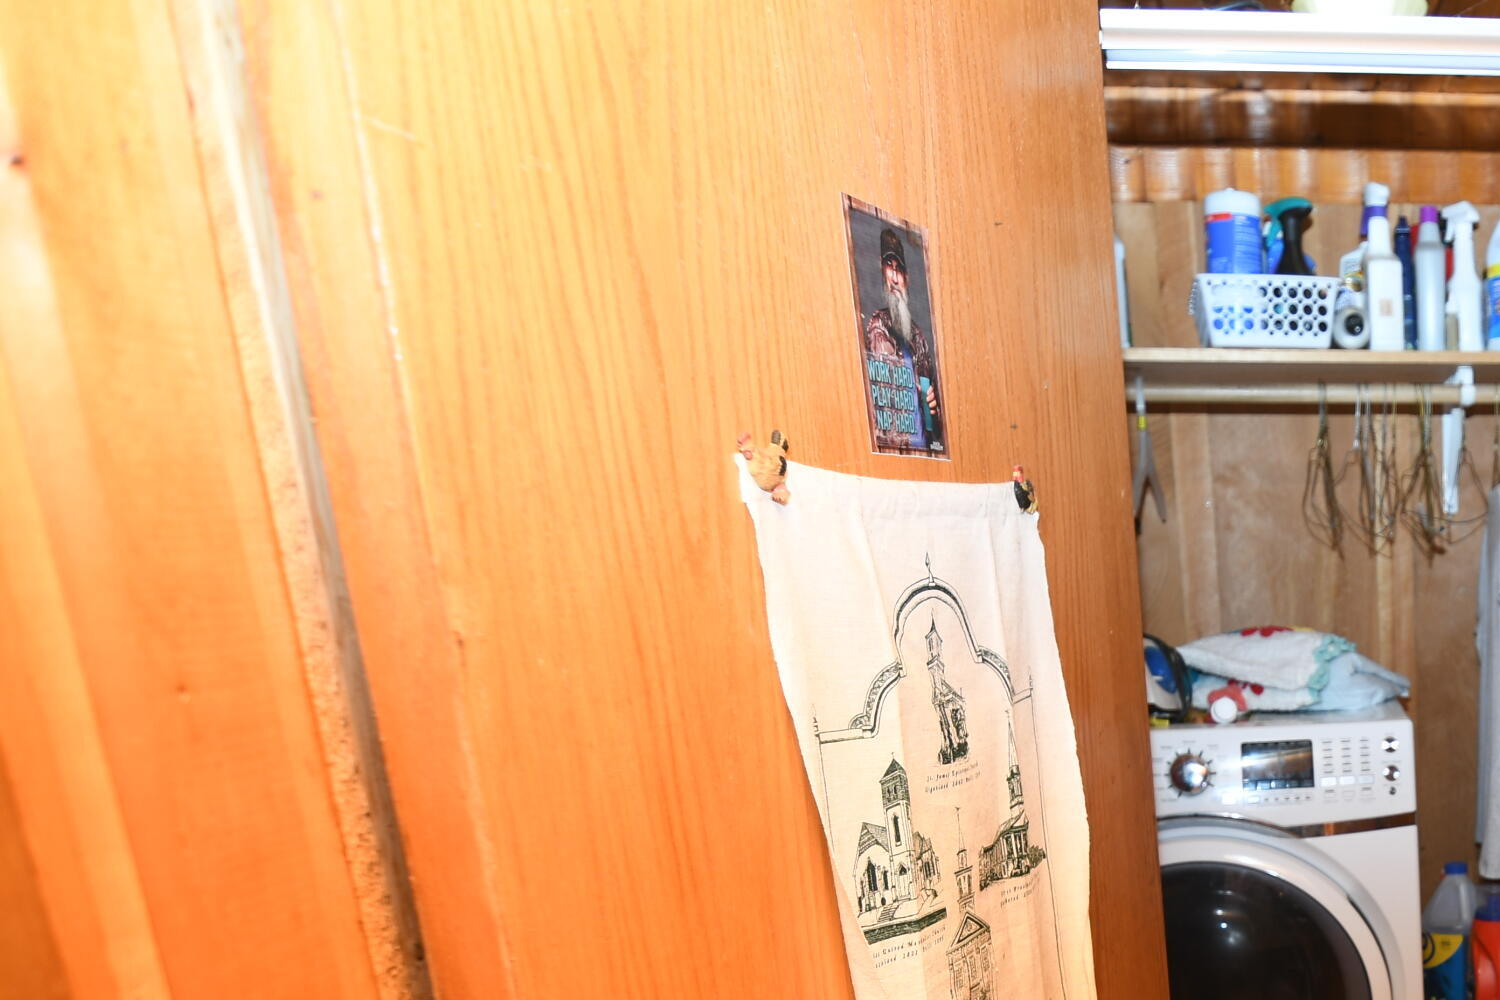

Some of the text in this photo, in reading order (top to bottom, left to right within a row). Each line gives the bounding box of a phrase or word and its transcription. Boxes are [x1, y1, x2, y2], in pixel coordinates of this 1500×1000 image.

[867, 360, 915, 389] WORK HARD.
[871, 384, 892, 407] PLAY
[876, 410, 917, 434] NAP HARD.
